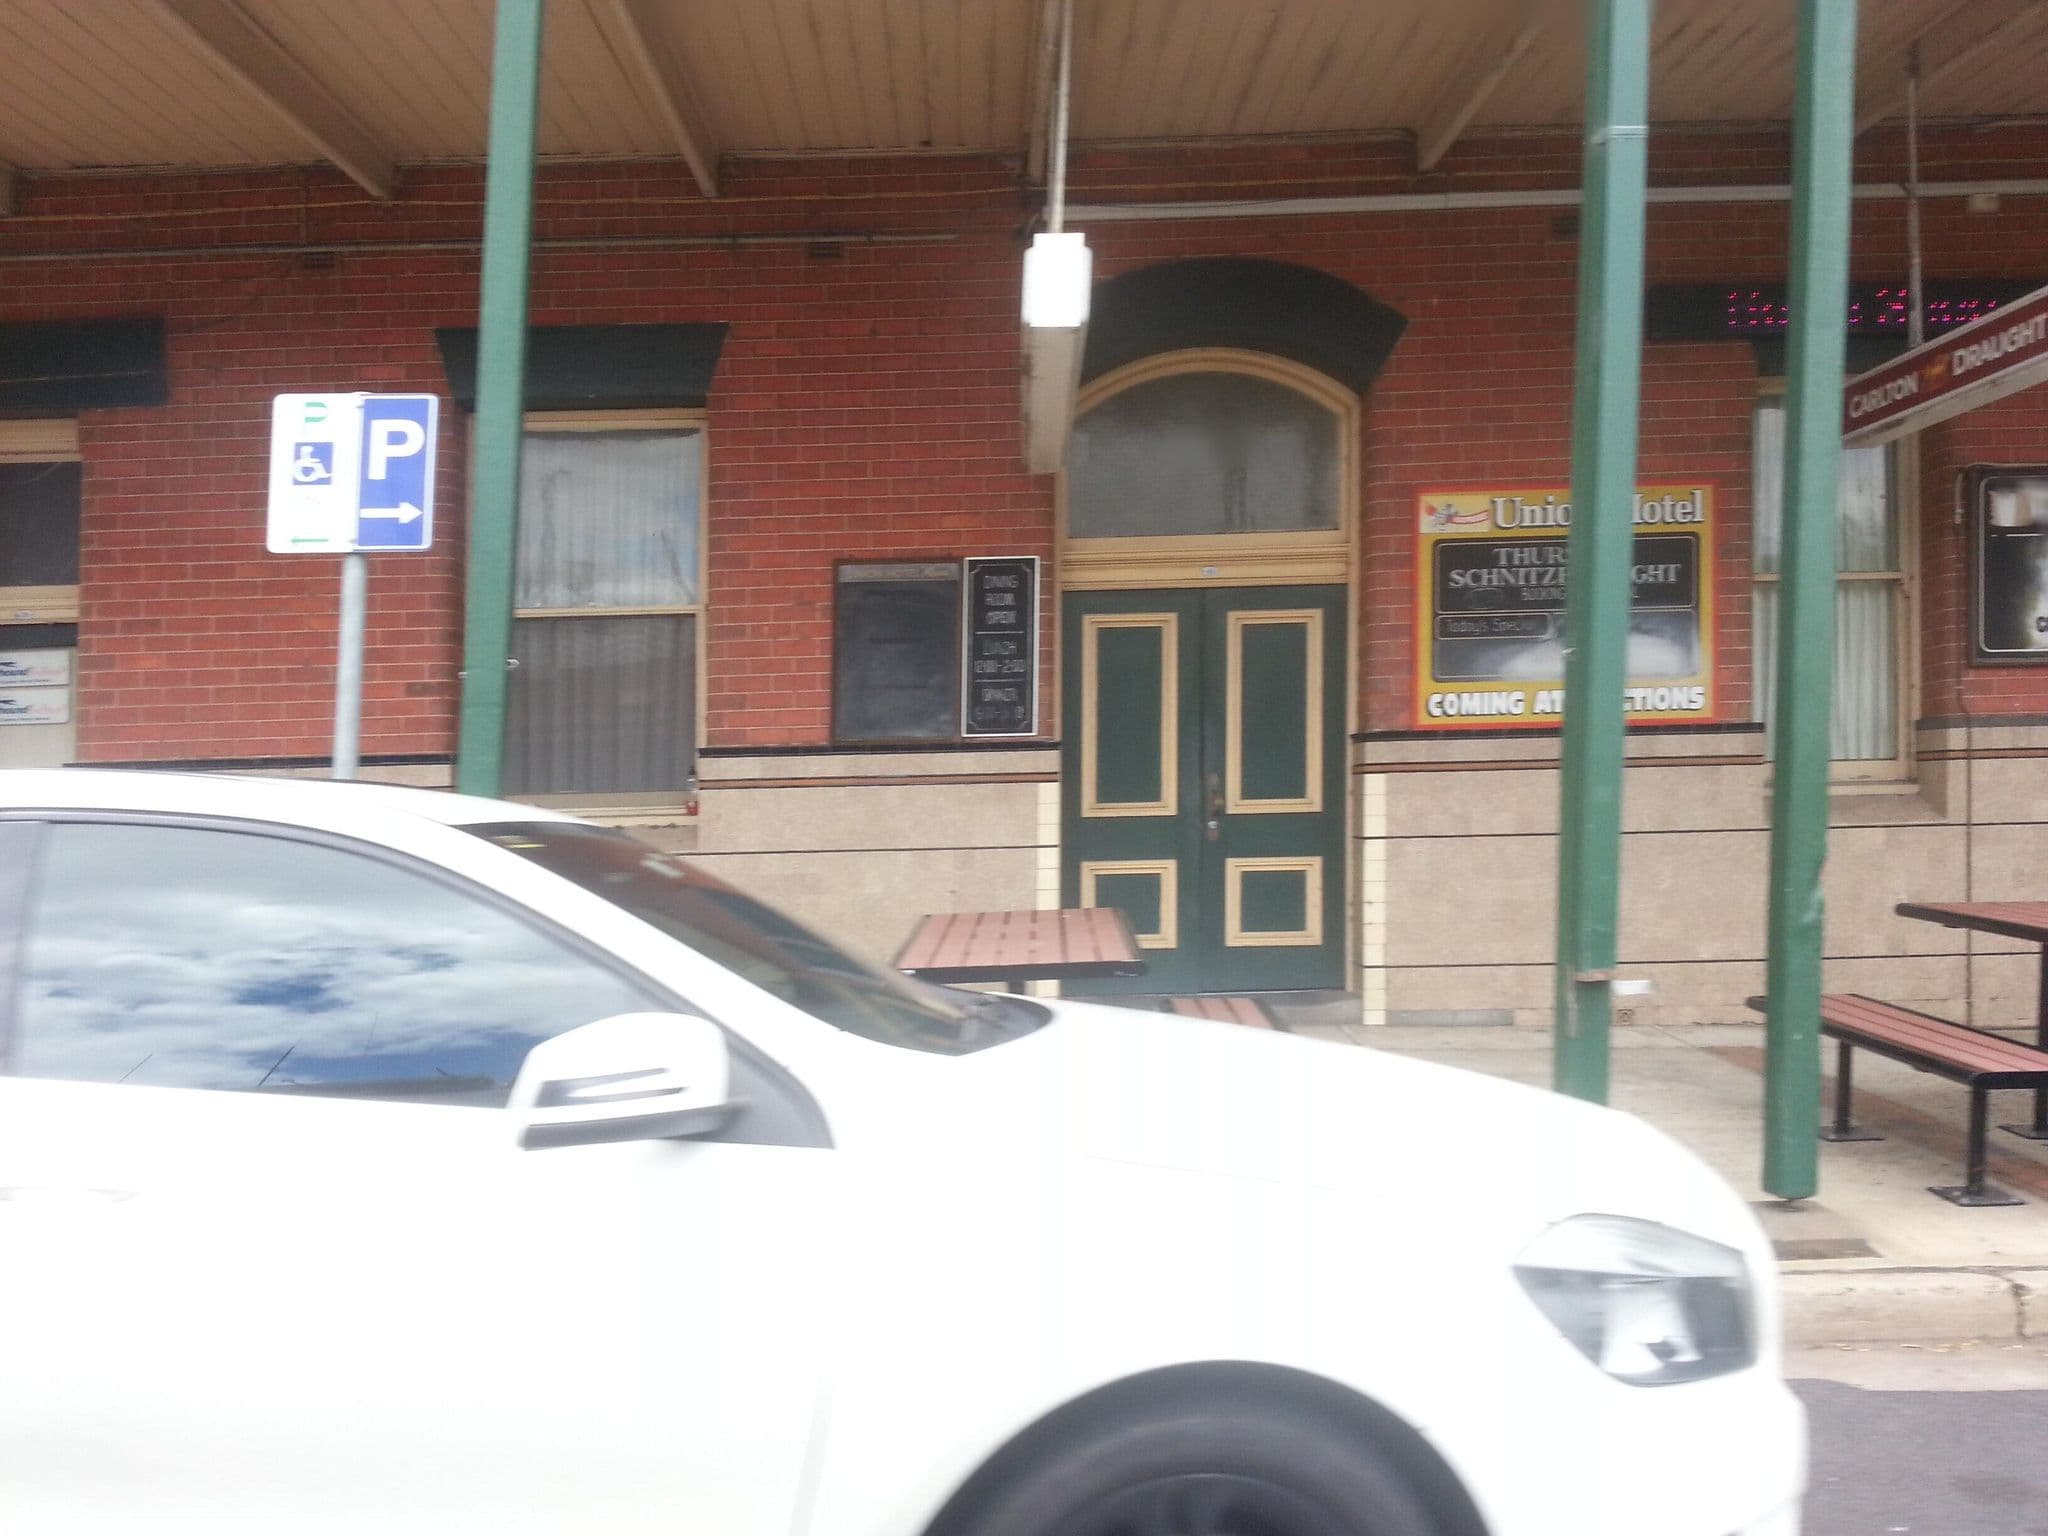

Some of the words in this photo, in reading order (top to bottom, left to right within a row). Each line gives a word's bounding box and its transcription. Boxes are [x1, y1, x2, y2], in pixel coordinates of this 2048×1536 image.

[1850, 373, 1920, 419] CARLTON
[1953, 316, 2048, 376] DRAUGHT
[368, 419, 426, 480] P
[1492, 495, 1573, 528] Unio
[1449, 567, 1569, 588] SCHNITZE
[1631, 563, 1682, 585] GHT
[1427, 690, 1526, 717] COMING
